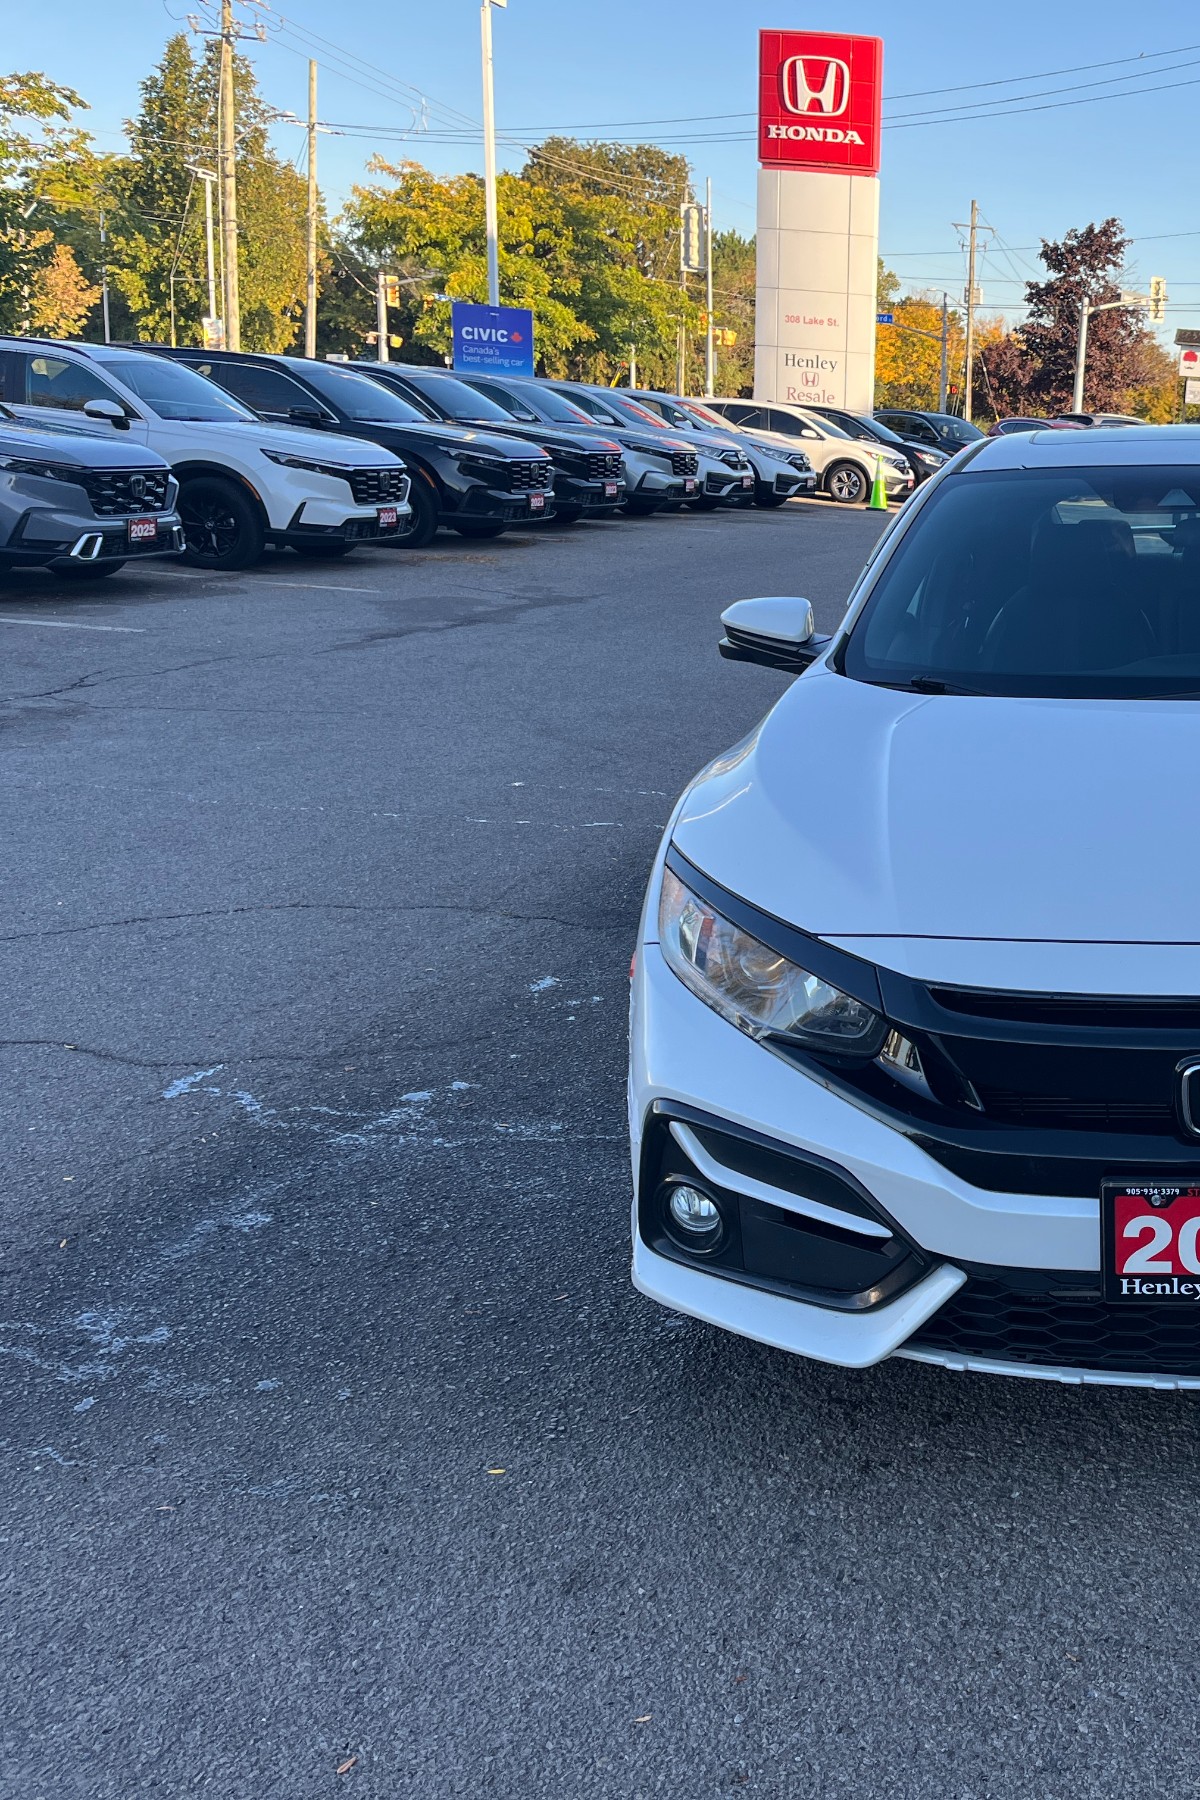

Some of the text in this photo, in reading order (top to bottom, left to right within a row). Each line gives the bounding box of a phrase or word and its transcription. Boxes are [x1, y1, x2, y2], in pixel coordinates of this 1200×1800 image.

[767, 124, 865, 145] HONDA
[784, 314, 840, 327] 308 Lake St.
[461, 326, 508, 343] CIVIC
[462, 345, 500, 356] Canada's
[463, 354, 510, 367] best-selling
[784, 353, 838, 372] Henley
[786, 386, 835, 404] Resale
[379, 512, 397, 522] 2023
[131, 523, 156, 537] 2025
